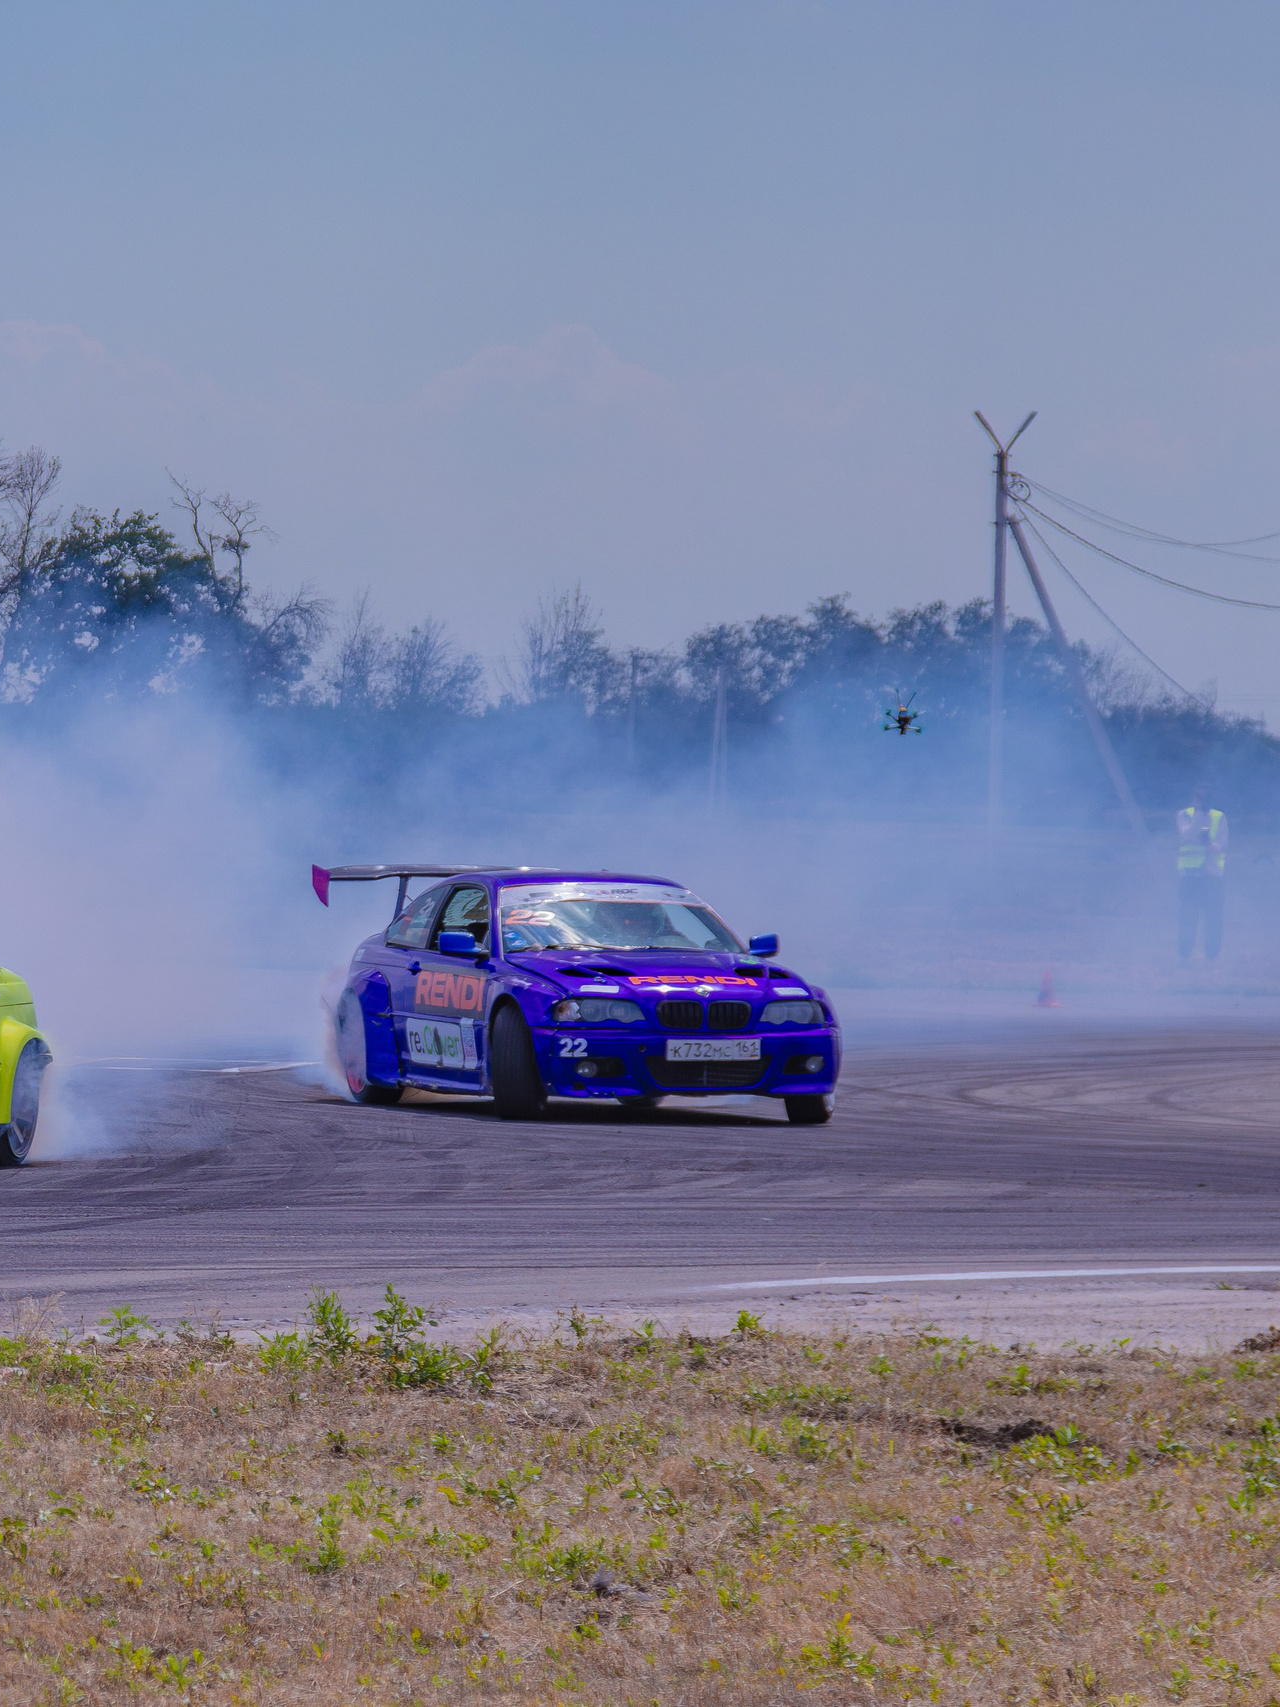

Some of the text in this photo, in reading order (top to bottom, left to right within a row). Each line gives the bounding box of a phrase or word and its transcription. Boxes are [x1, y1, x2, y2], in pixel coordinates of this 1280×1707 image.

[505, 909, 555, 926] 22
[628, 975, 758, 986] RENDI
[415, 970, 486, 1012] RENDI
[558, 1037, 588, 1058] 22
